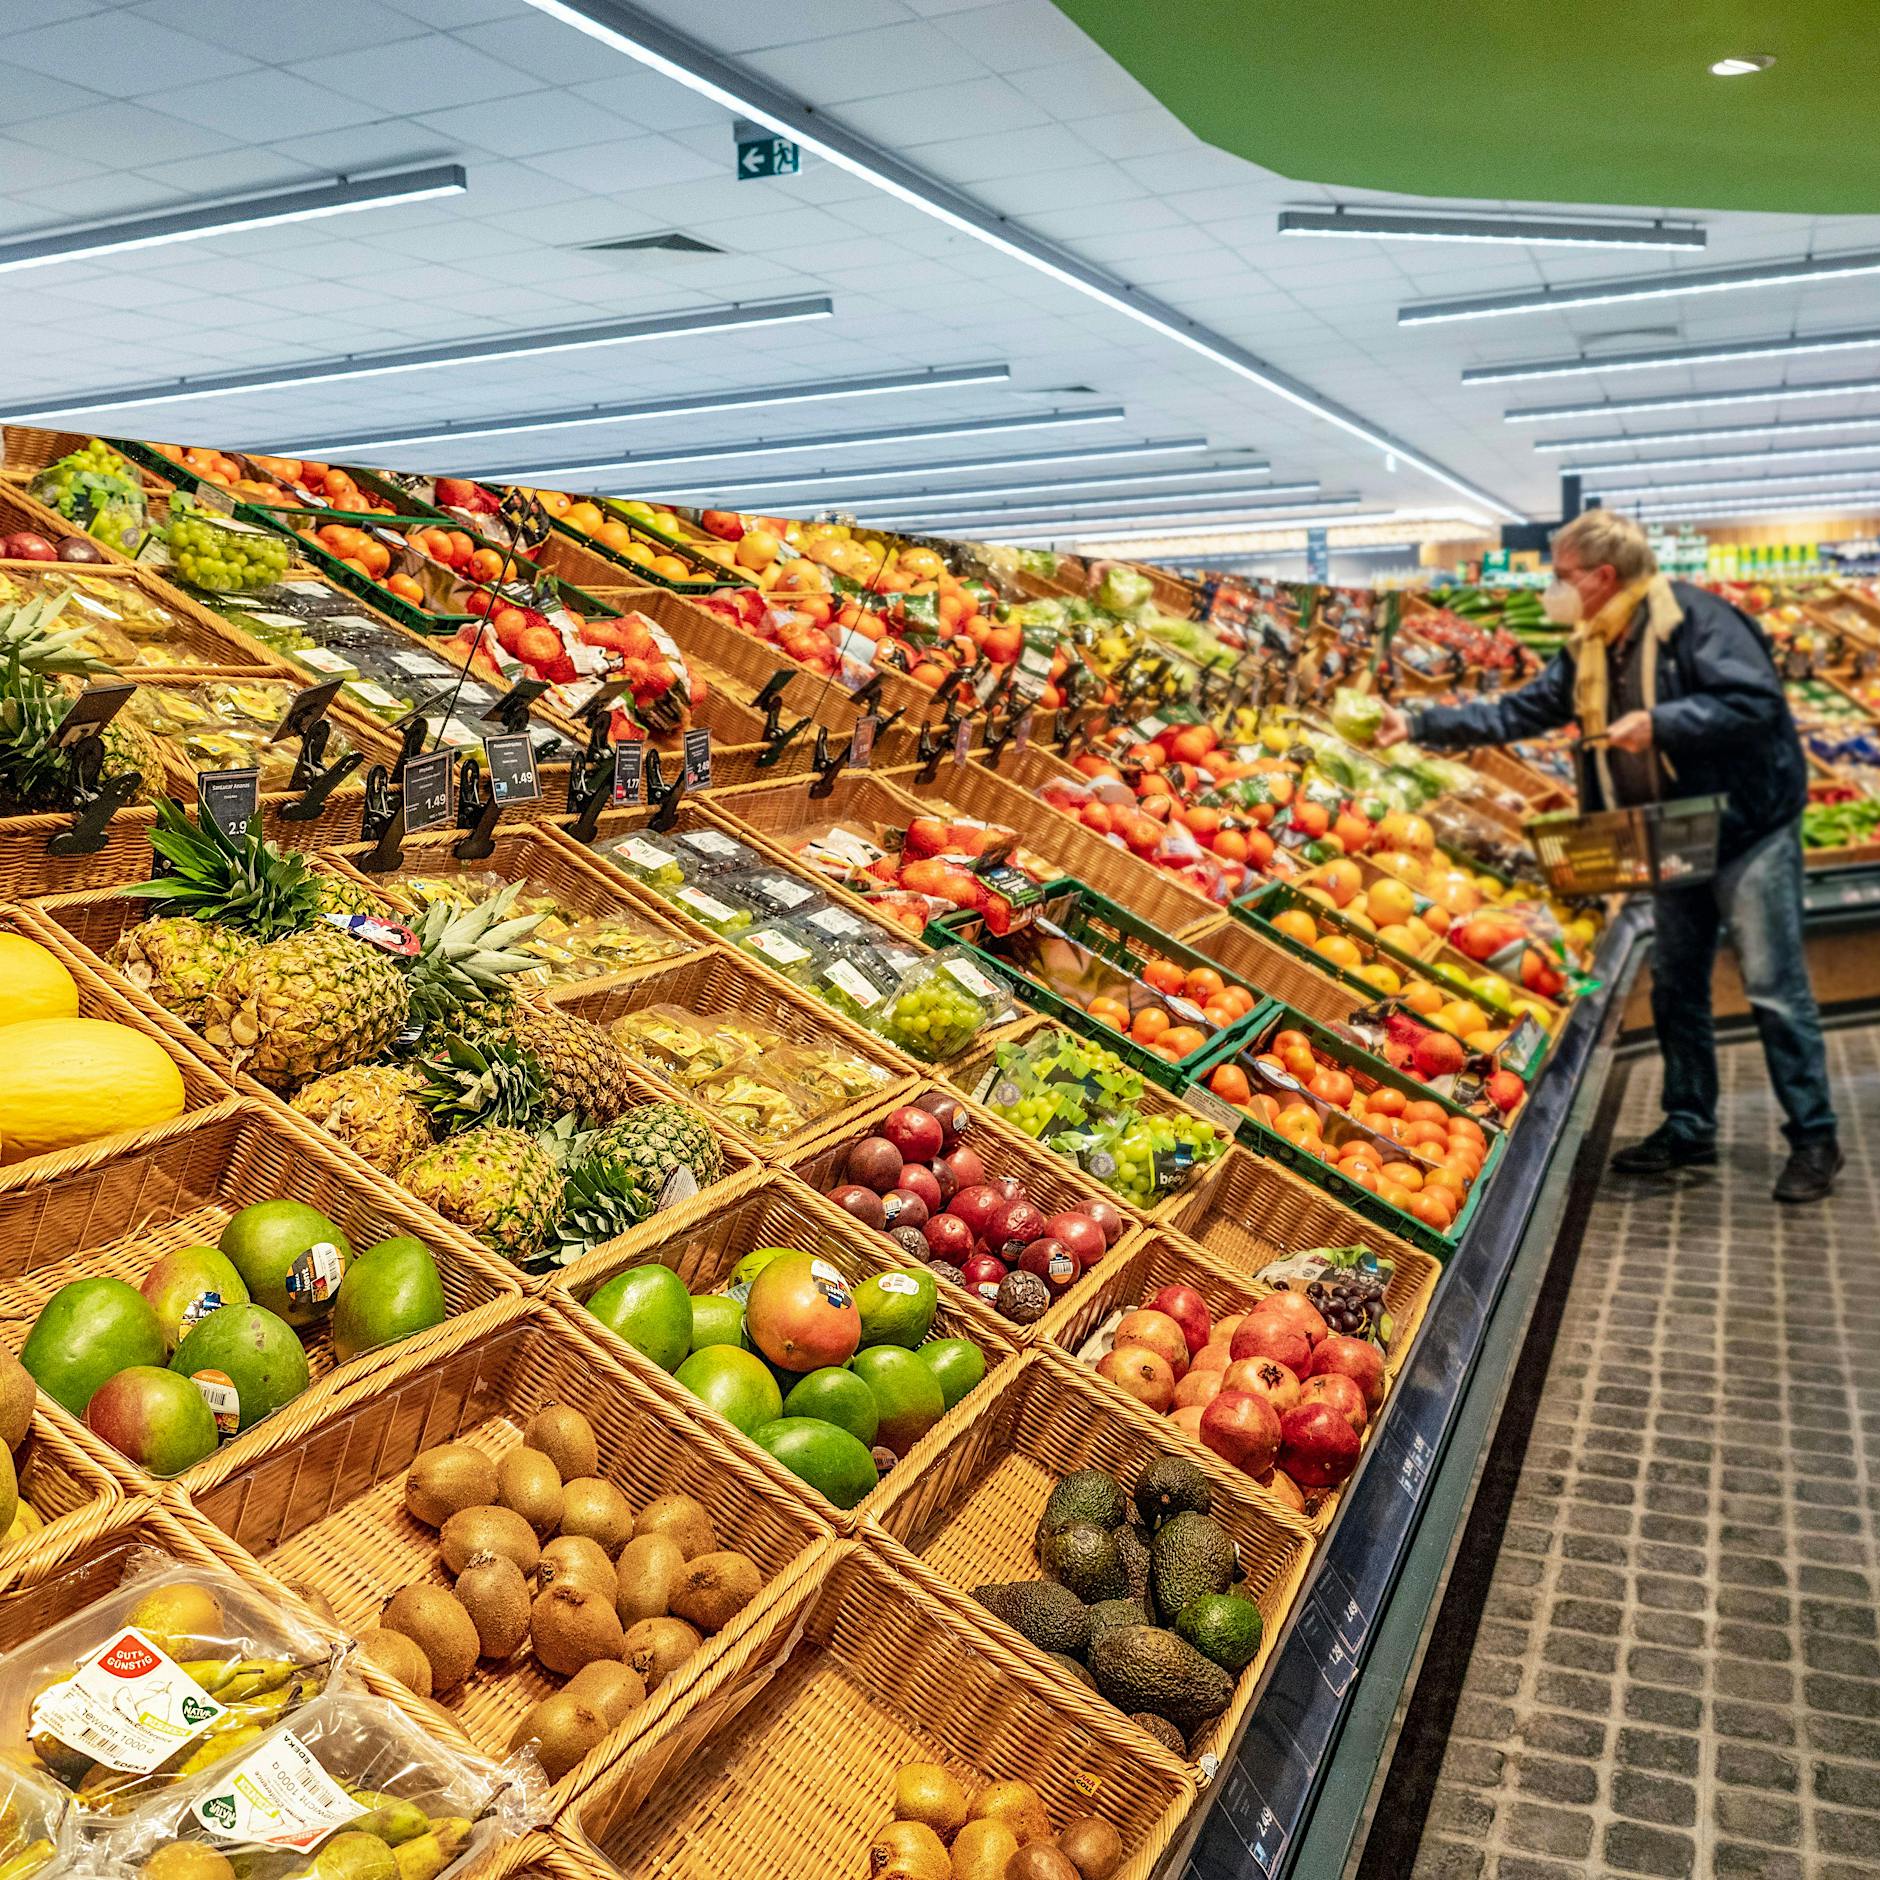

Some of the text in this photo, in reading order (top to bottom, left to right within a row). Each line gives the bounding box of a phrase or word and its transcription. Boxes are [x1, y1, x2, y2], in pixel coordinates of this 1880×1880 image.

[511, 771, 533, 784] 1.49
[425, 793, 446, 810] 1.49
[228, 820, 247, 835] 2.9
[301, 1267, 311, 1291] kent
[106, 1655, 153, 1671] GÜNSTIG
[120, 1734, 146, 1752] 1000
[283, 1734, 311, 1765] EDEKA
[113, 1759, 148, 1772] EDEKA
[276, 1770, 300, 1795] 1000
[1255, 1806, 1273, 1838] 2.49
